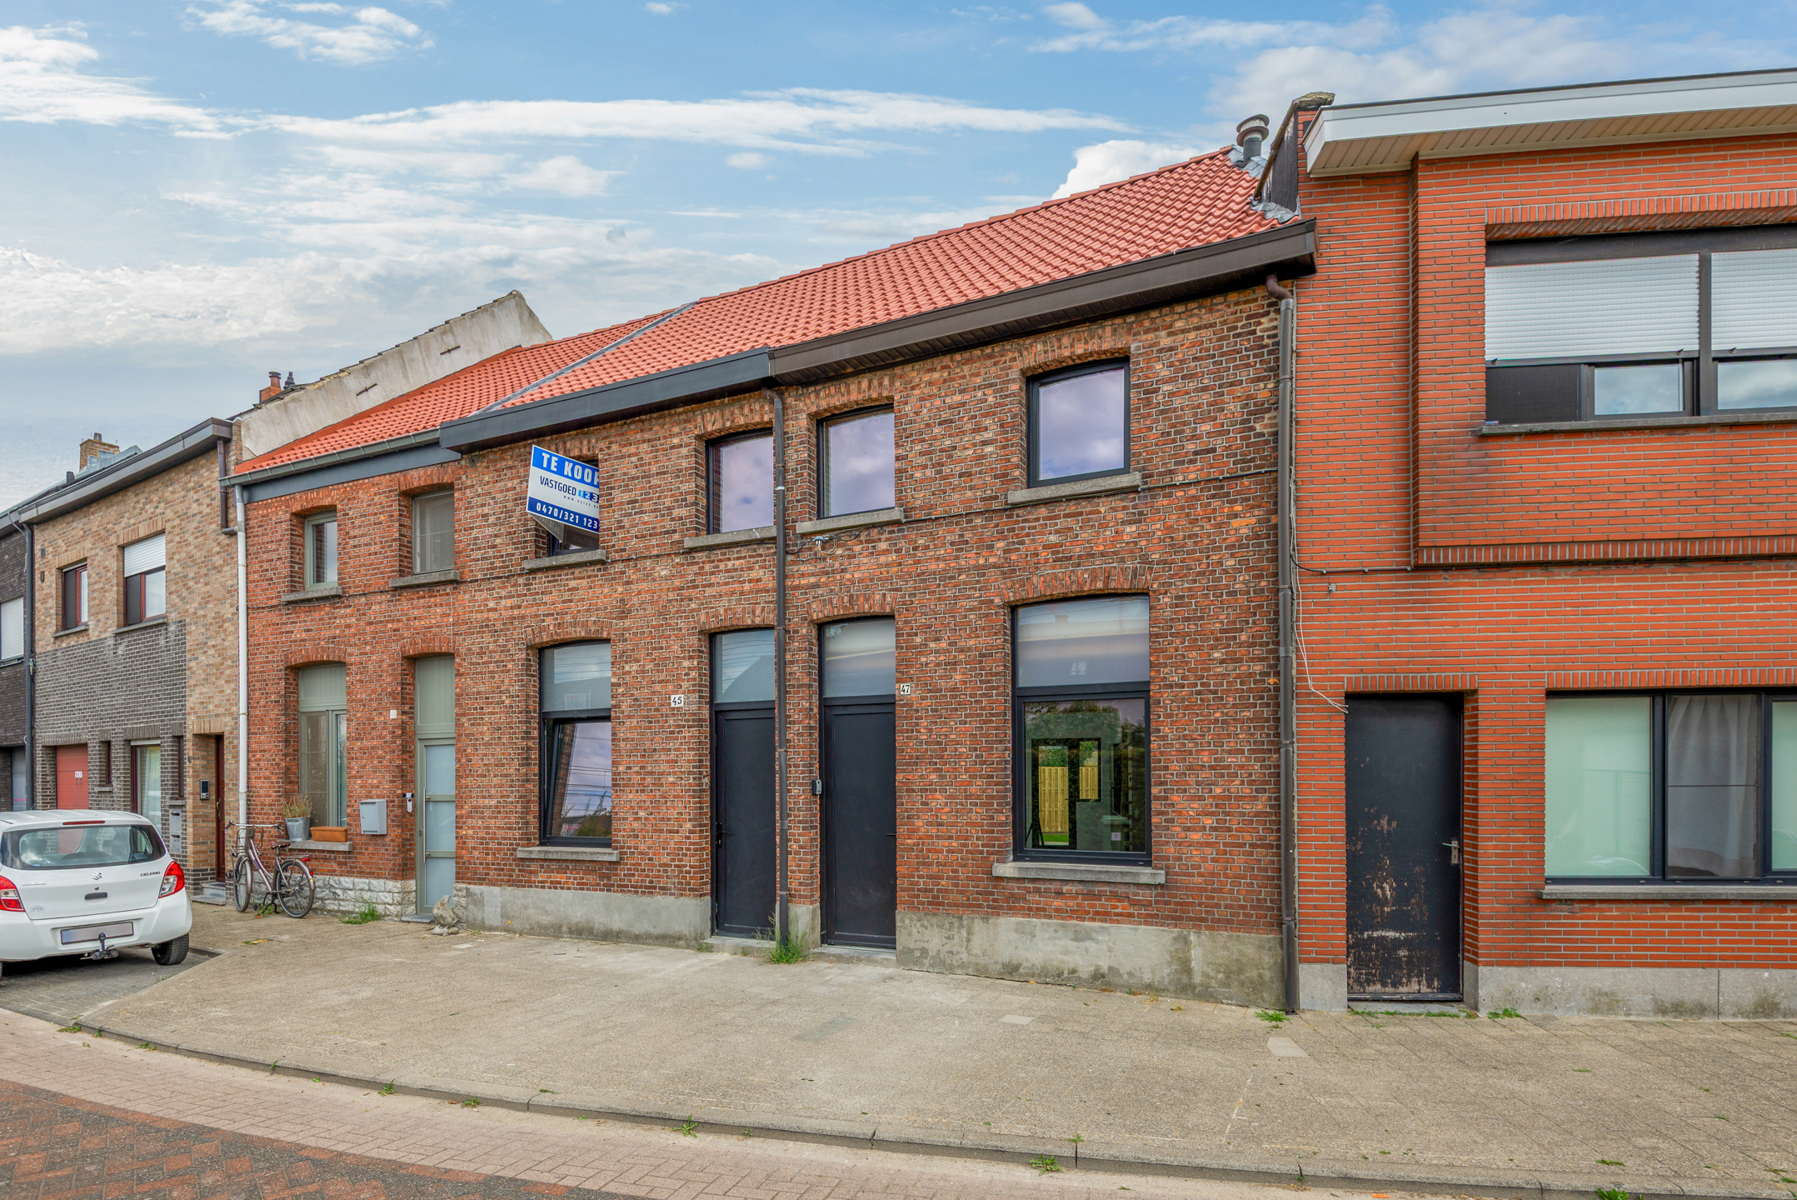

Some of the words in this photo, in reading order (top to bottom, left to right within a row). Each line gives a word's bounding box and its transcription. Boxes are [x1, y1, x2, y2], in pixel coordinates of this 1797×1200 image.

[541, 452, 558, 471] TE
[540, 475, 577, 496] VASTGOED
[579, 490, 599, 502] 123
[536, 502, 579, 524] 0470/321
[583, 517, 598, 530] 123
[901, 684, 910, 693] 47
[672, 696, 683, 706] 45
